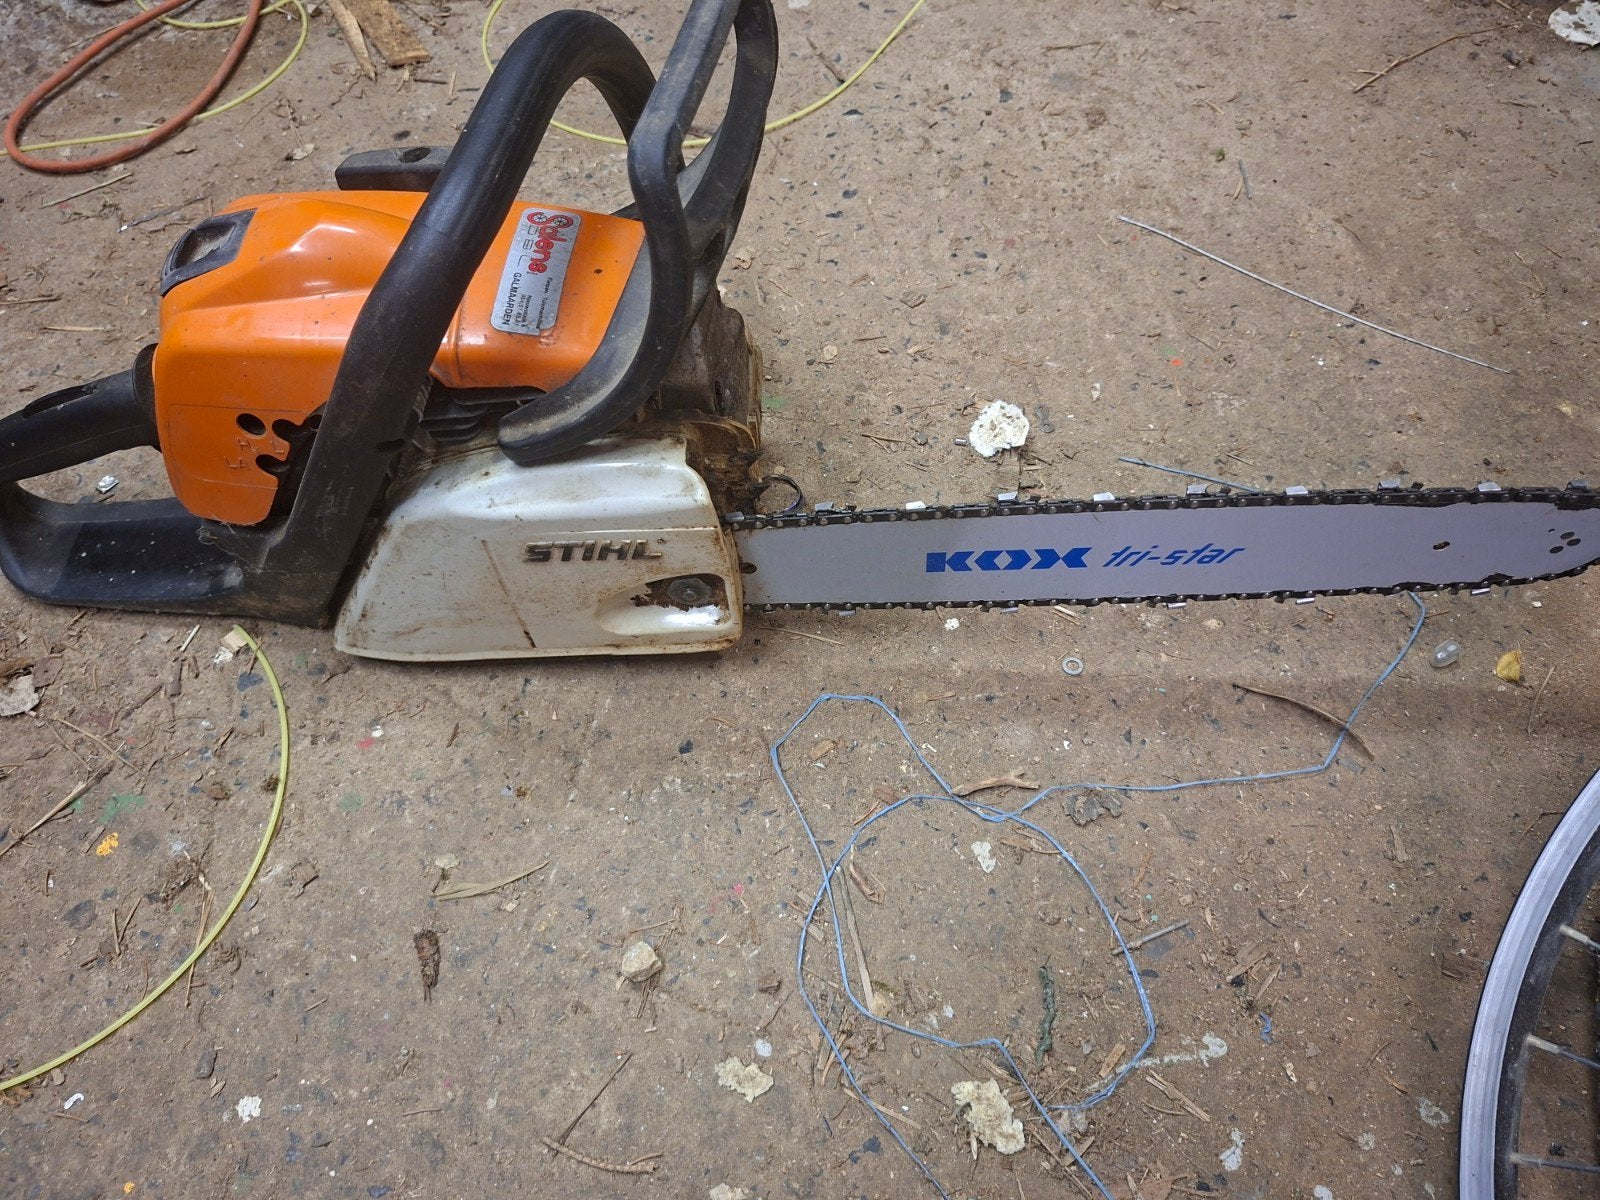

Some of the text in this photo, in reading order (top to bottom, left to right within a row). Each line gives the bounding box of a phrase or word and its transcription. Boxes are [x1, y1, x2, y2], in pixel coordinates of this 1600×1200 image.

[502, 272, 522, 326] GALMAARDEN
[523, 539, 662, 562] STIHL
[926, 543, 1246, 572] KOX tri-star
